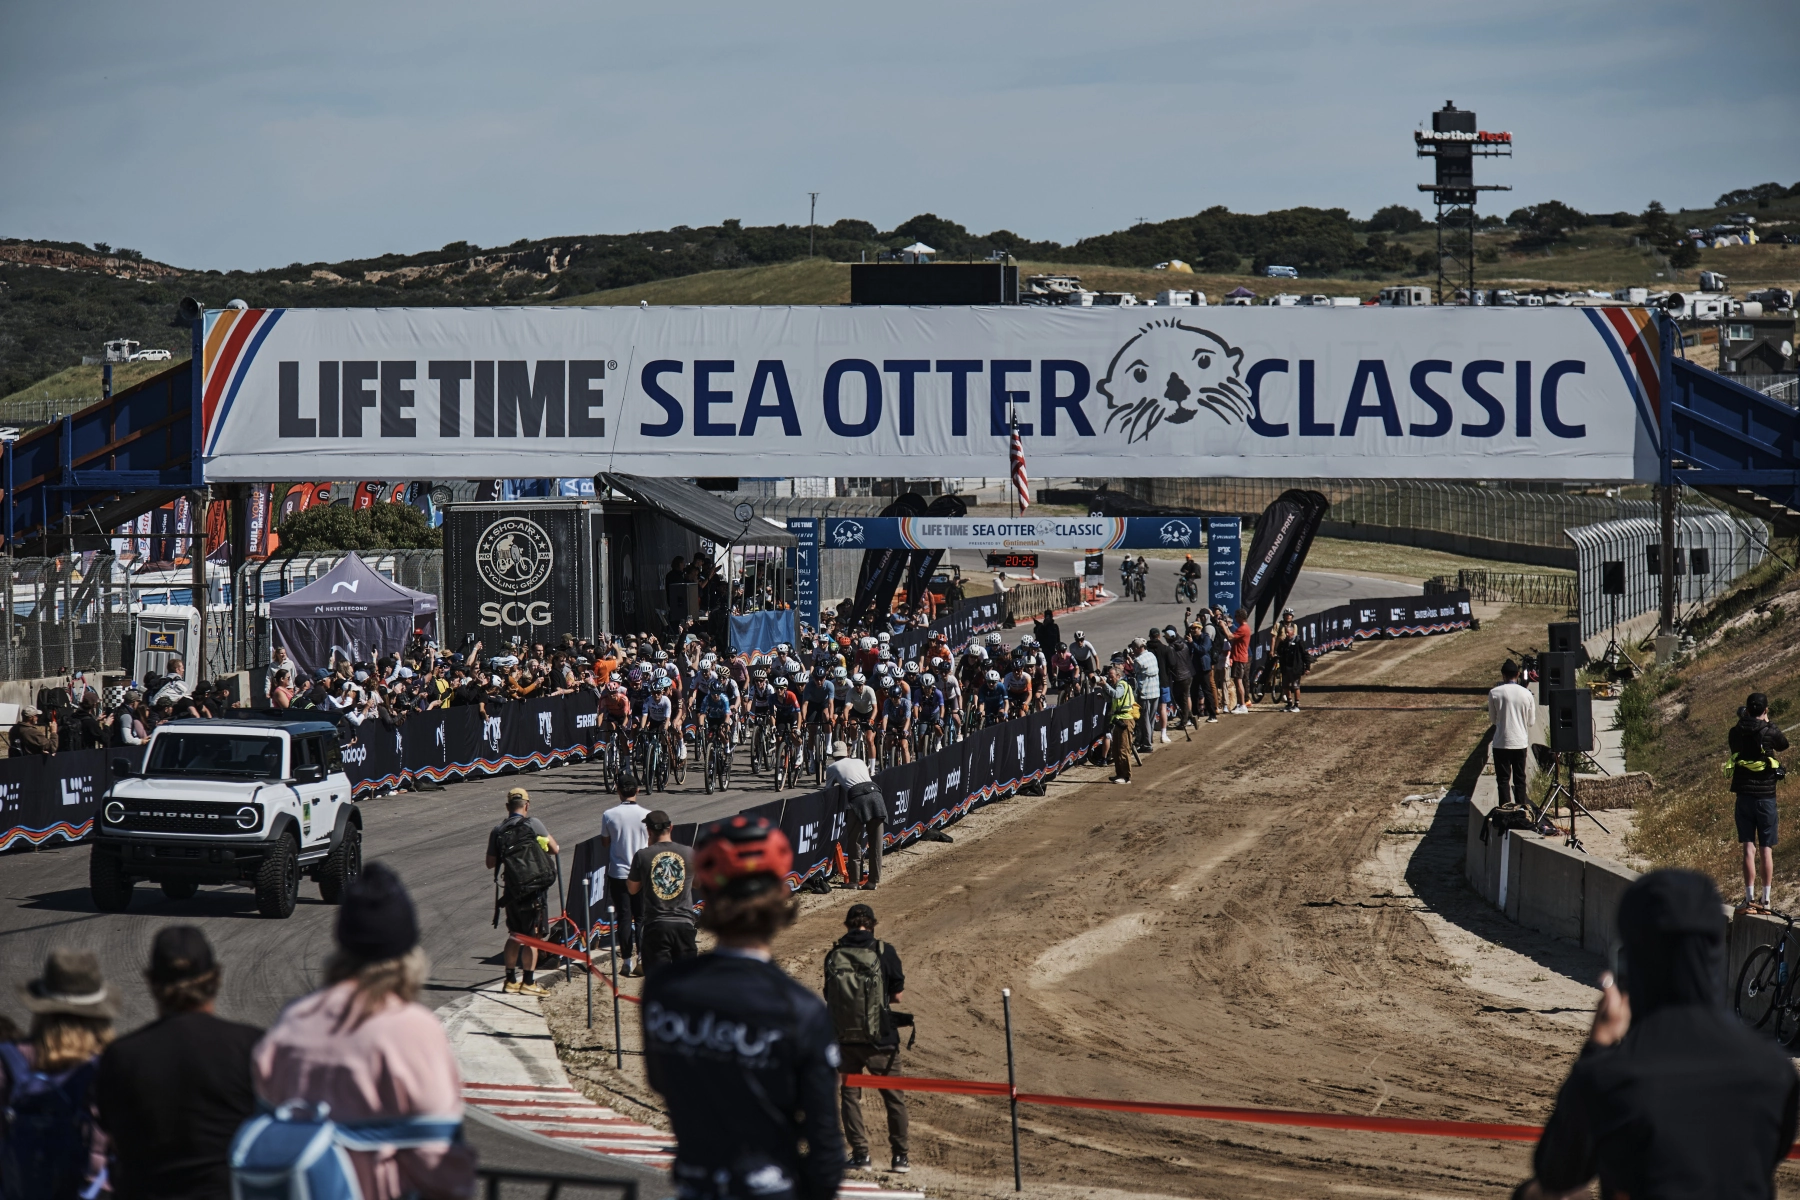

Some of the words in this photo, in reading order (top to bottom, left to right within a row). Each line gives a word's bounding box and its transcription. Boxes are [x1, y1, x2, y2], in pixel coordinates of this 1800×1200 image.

[640, 358, 802, 438] SEA
[822, 358, 1096, 438] OTTER
[1246, 358, 1586, 438] CLASSIC
[492, 522, 537, 536] SHO-AIR
[972, 524, 995, 536] SEA
[998, 524, 1035, 536] OTTER
[1056, 524, 1103, 536] CLASSIC
[1264, 534, 1284, 564] GRAND
[1282, 513, 1295, 535] PRIX
[1003, 539, 1040, 547] Continental
[520, 564, 546, 589] GROUP
[480, 601, 552, 627] SCG
[140, 812, 219, 820] BRONCO
